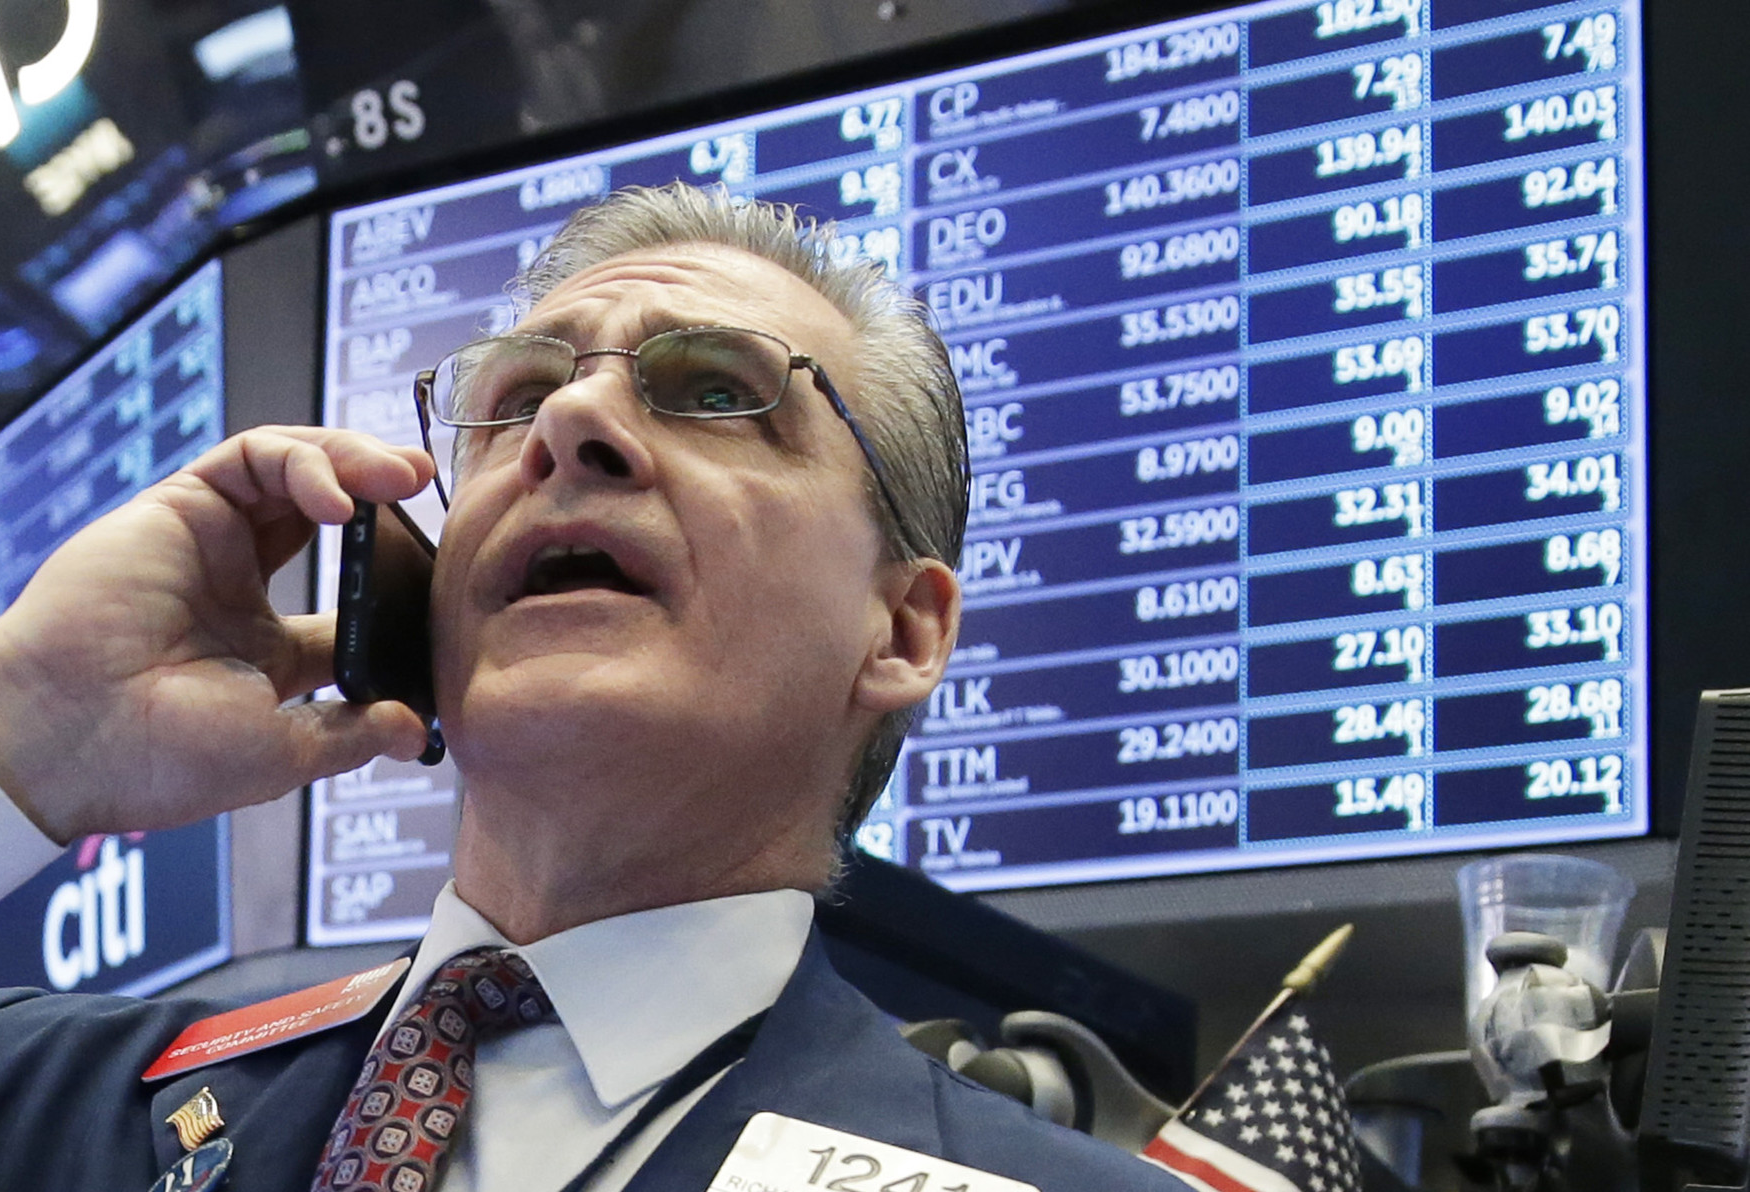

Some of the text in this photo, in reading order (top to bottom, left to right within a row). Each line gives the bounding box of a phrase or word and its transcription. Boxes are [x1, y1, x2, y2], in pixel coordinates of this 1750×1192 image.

[928, 13, 1617, 186] CX 7.4800 7.29 7.49
[929, 82, 979, 122] CP
[1105, 22, 1240, 82] 184.2900
[928, 207, 1007, 252] DEO
[1104, 159, 1240, 216] 140.3600
[1315, 123, 1422, 177] 139.94
[1503, 85, 1618, 141] 140.03
[928, 272, 1003, 315] EDU
[1120, 227, 1240, 280] 92.6800
[1333, 192, 1423, 243] 90.18
[1522, 157, 1618, 208] 92.64
[949, 337, 1008, 380] MC
[1120, 296, 1240, 348] 35.5300
[1332, 265, 1424, 314] 35.55
[1523, 230, 1619, 282] 35.74
[1120, 365, 1240, 416] 53.7500
[1332, 336, 1425, 385] 53.69
[1523, 304, 1621, 354] 53.70
[1137, 435, 1240, 482] 8.9700
[1352, 408, 1425, 453] 9.00
[1543, 378, 1621, 424] 9.02
[1119, 506, 1240, 554] 32.5900
[1332, 481, 1423, 527] 32.31
[1524, 452, 1621, 502] 34.01
[1136, 528, 1622, 621] 8.6100 8.63 8.68
[1117, 646, 1239, 693] 30.1000
[1332, 625, 1426, 672] 27.10
[1523, 602, 1623, 649] 33.10
[921, 745, 997, 788] TTM
[1117, 718, 1239, 764] 29.2400
[1332, 699, 1426, 743] 28.46
[1523, 678, 1623, 725] 28.68
[920, 815, 972, 857] TV
[1117, 790, 1239, 834] 19.1100
[1333, 773, 1426, 817] 15.49
[1523, 754, 1623, 800] 20.12
[167, 993, 369, 1060] SECURITY AND SAFETY
[204, 1018, 313, 1056] COMMITTEE
